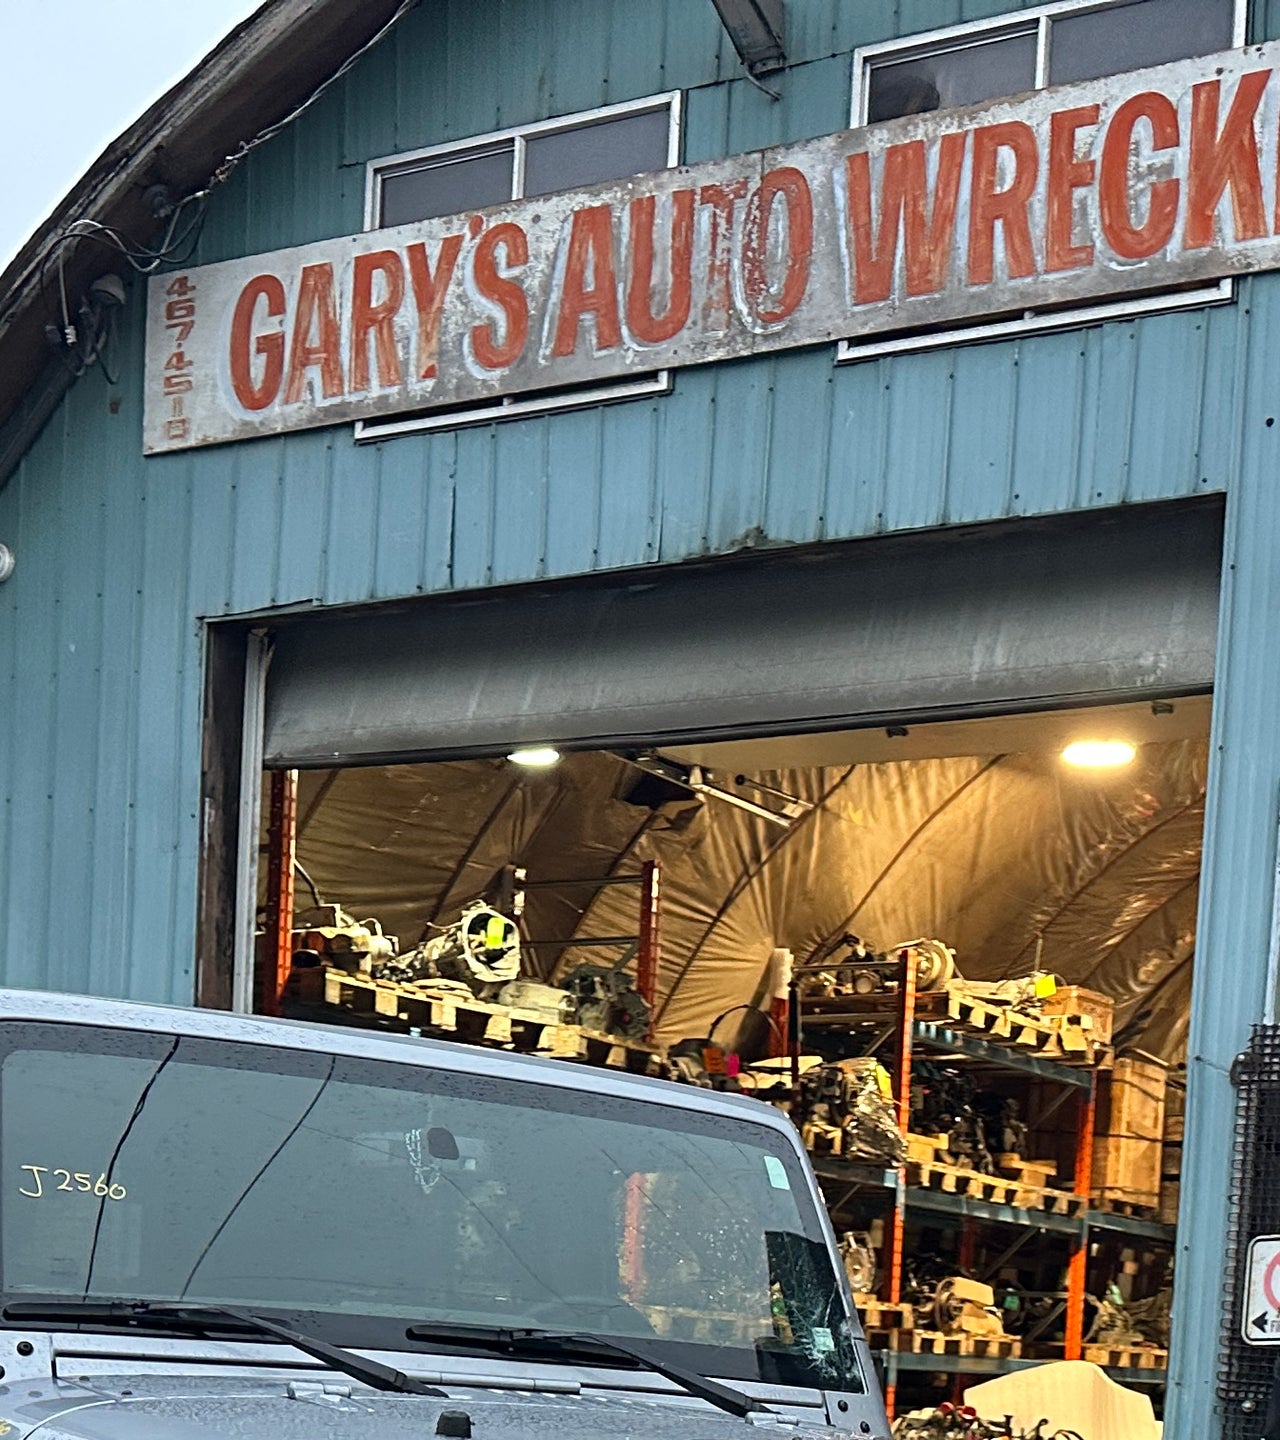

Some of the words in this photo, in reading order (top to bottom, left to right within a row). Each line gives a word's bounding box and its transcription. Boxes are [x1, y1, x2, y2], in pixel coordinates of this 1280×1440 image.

[229, 214, 529, 411] GARY'S
[551, 166, 812, 358] AUTO
[19, 1165, 127, 1200] J2560
